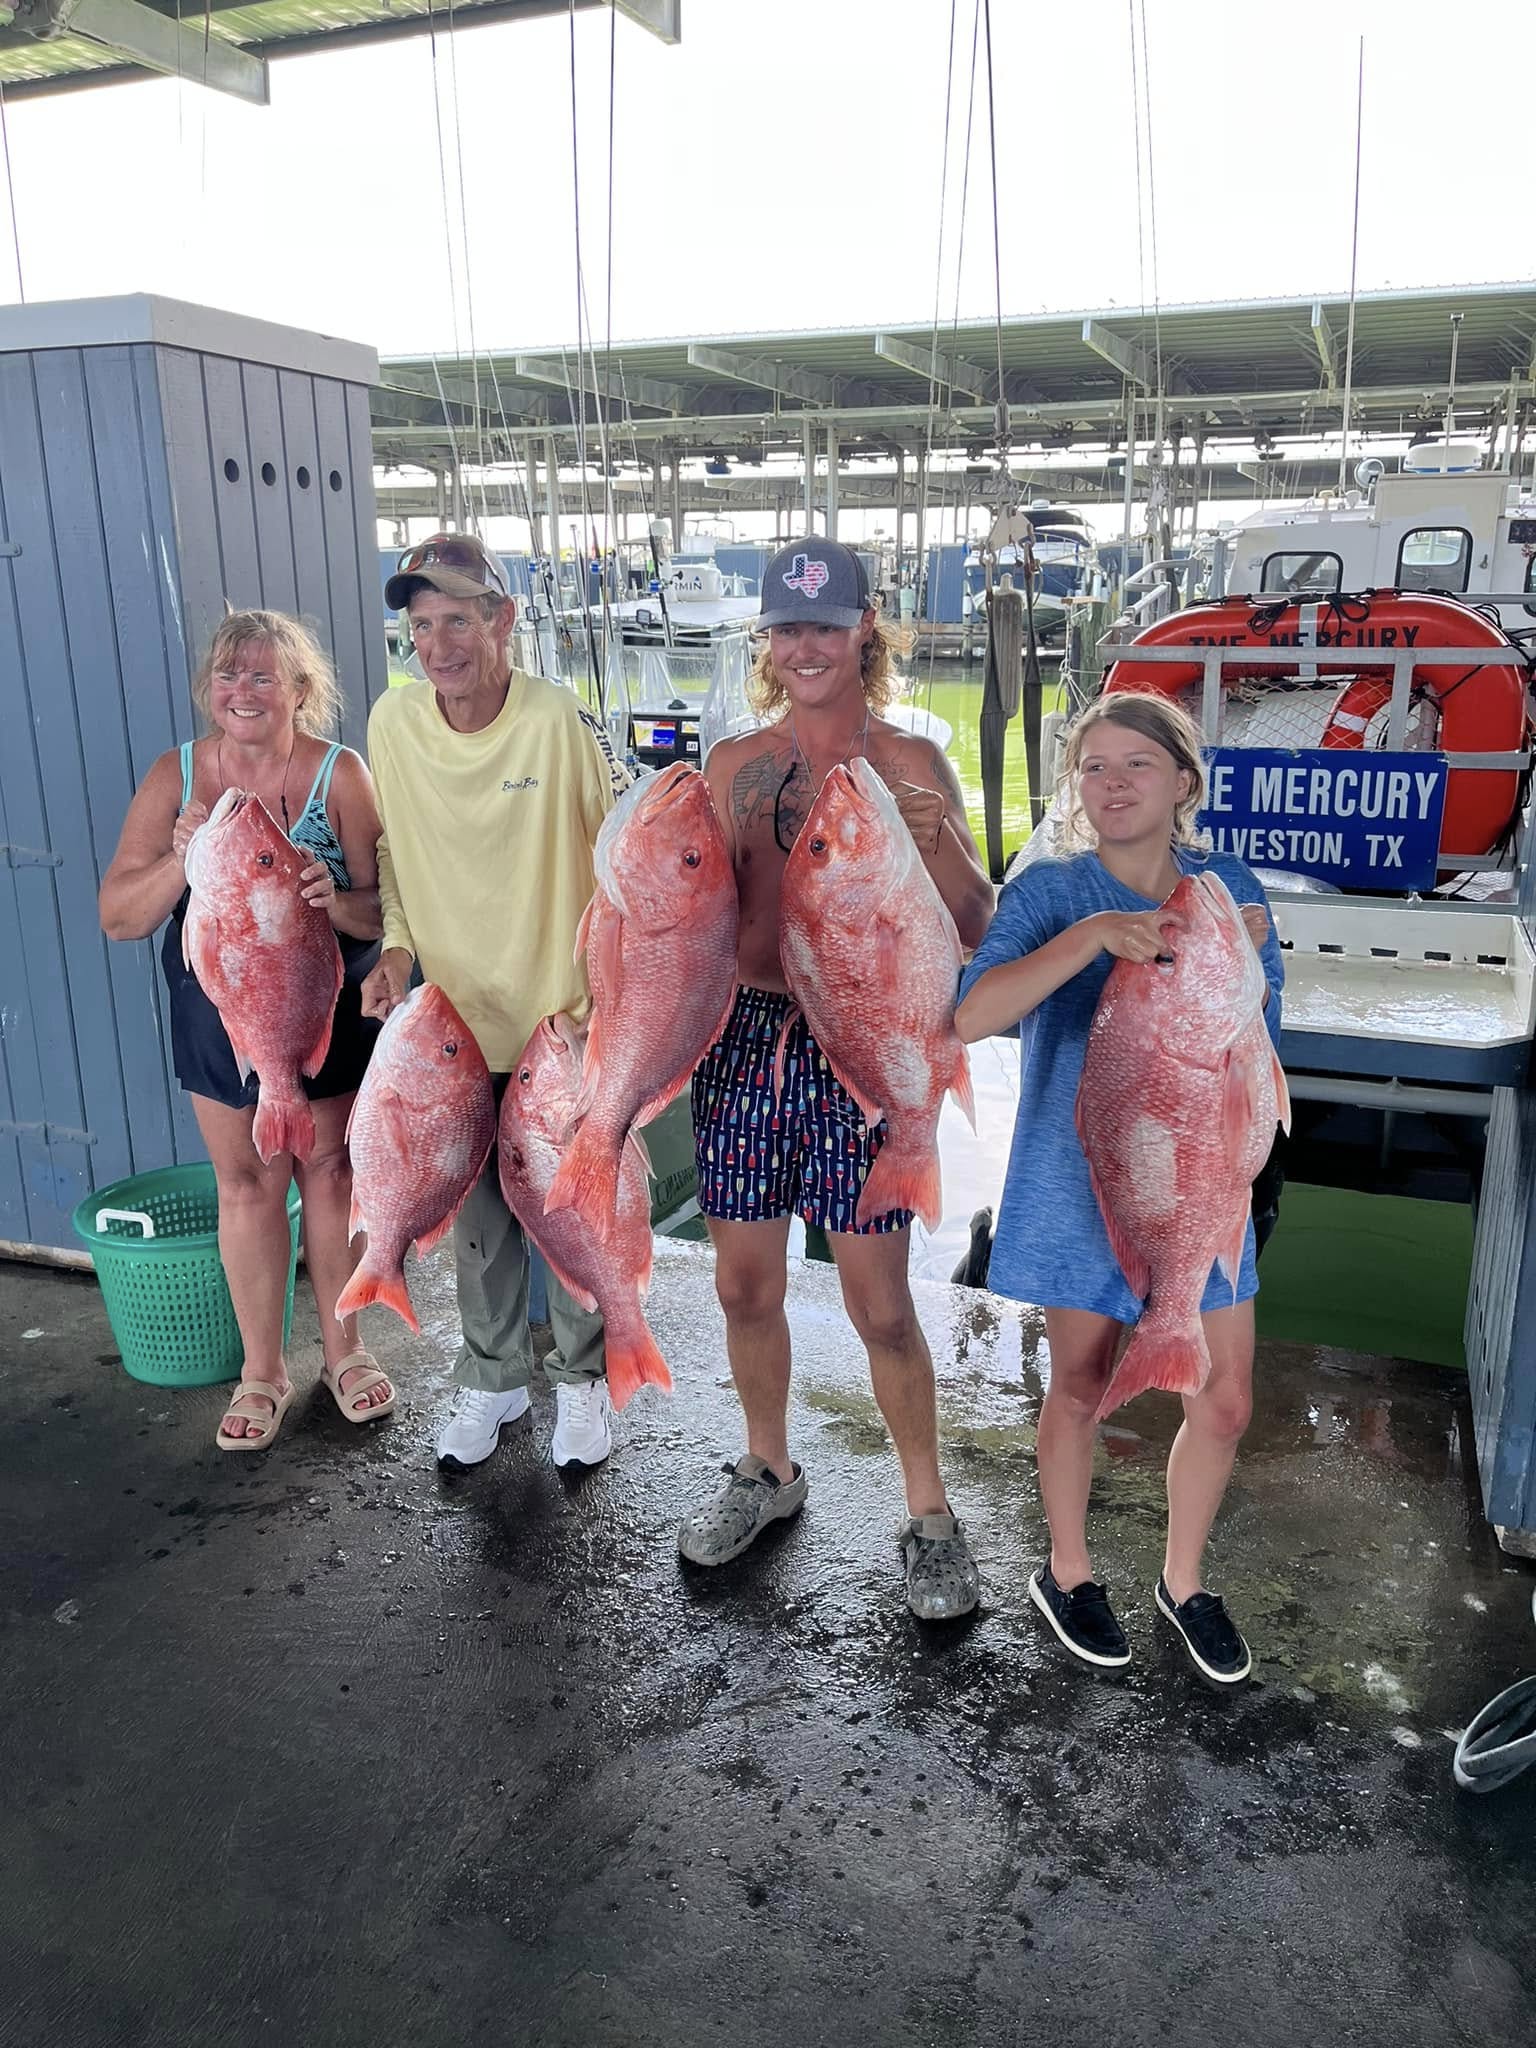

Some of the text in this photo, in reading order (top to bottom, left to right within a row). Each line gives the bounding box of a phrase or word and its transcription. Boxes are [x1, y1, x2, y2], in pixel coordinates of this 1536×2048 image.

[1251, 766, 1440, 820] MERCURY
[1202, 826, 1406, 868] ALVESTON, TX
